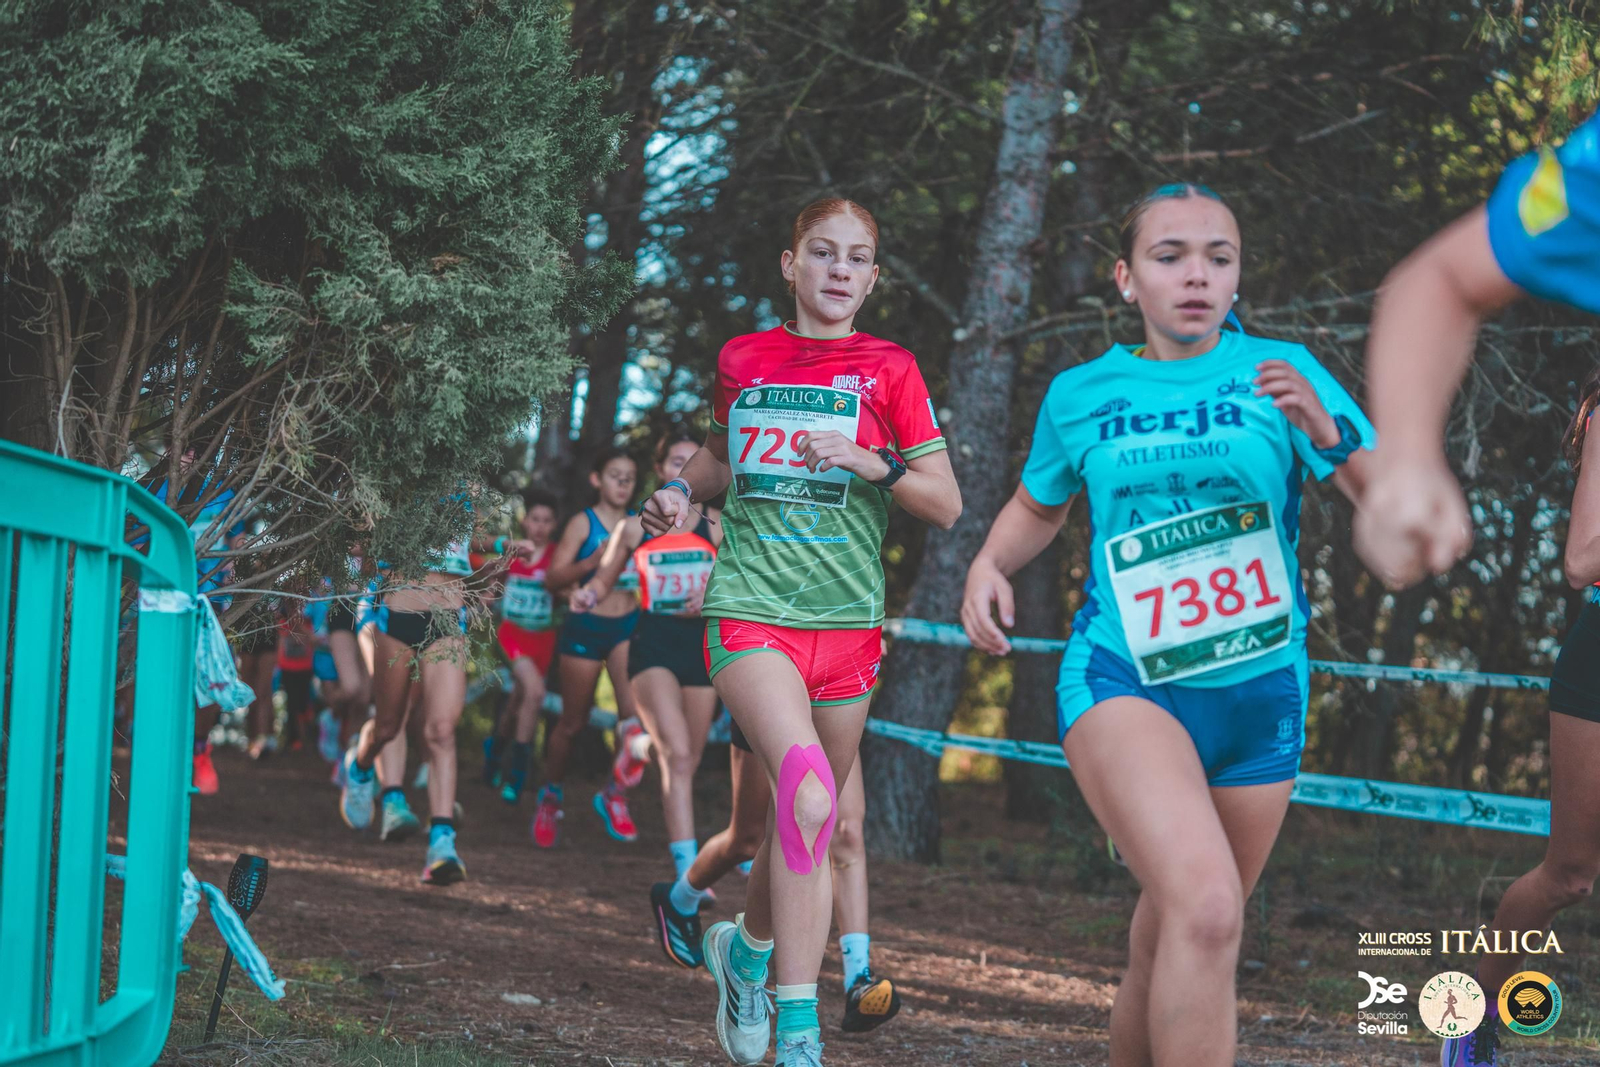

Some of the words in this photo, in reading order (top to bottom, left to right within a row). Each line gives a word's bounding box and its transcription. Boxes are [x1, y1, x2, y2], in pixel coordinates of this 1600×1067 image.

[767, 388, 825, 405] ITÁLICA
[800, 411, 834, 420] NAVARRETE
[1099, 400, 1245, 441] nerja
[738, 427, 811, 468] 729
[1117, 440, 1230, 468] ATLETISMO
[1151, 514, 1229, 549] ITÁLICA
[1134, 558, 1281, 638] 7381
